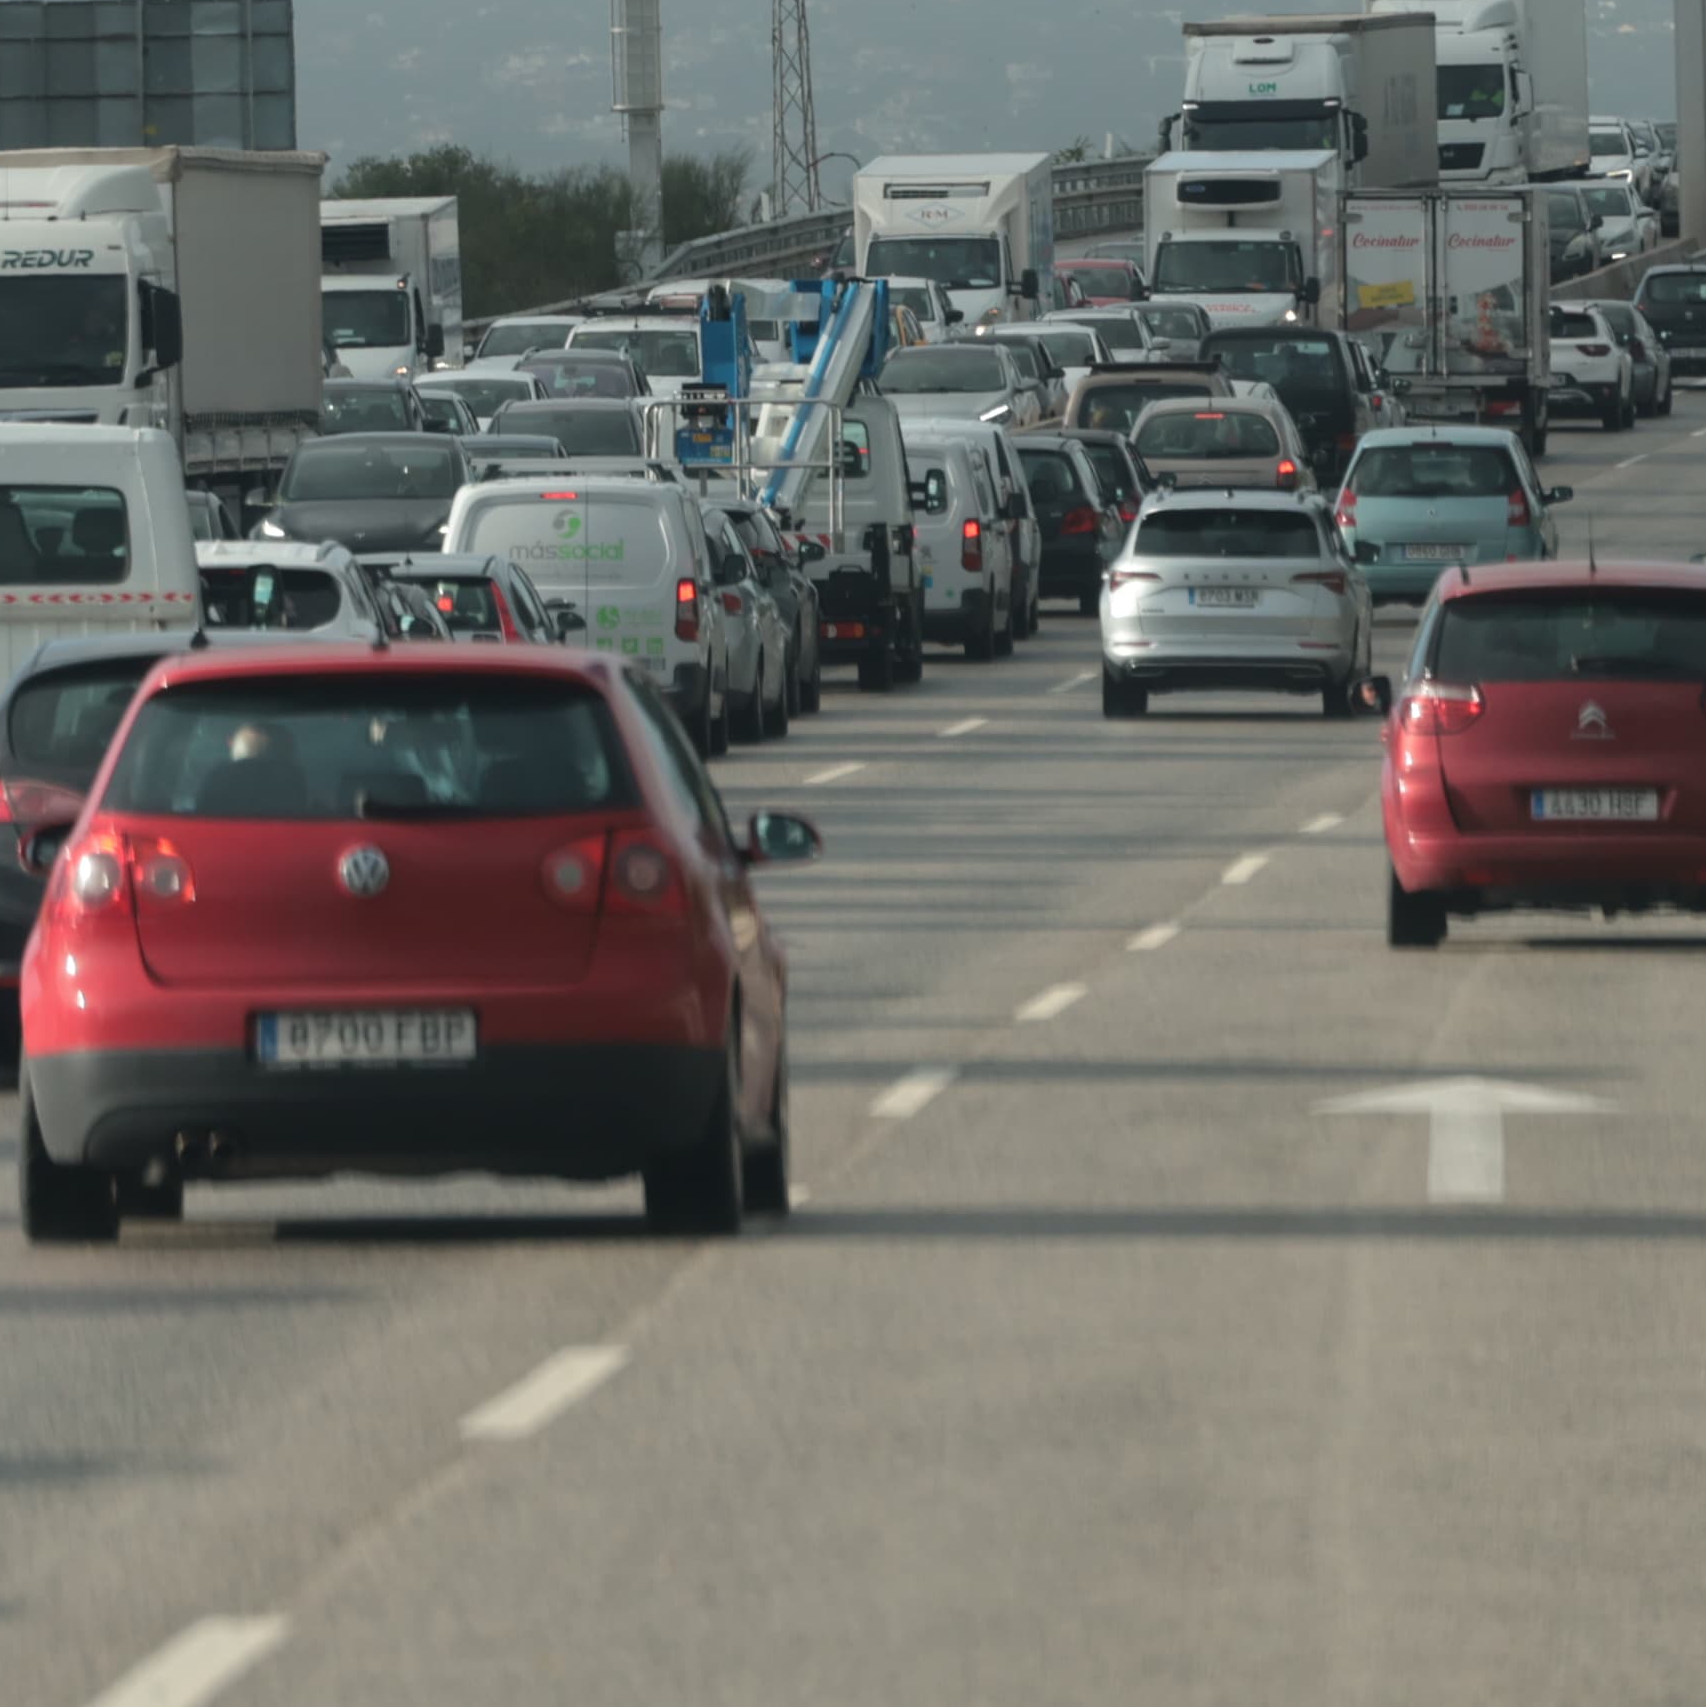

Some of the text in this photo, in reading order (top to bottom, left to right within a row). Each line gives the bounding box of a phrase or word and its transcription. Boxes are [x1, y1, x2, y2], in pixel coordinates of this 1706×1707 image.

[1248, 82, 1277, 94] LOM
[1352, 232, 1421, 250] Cocinatur
[1447, 232, 1516, 250] Cocinatur
[1, 249, 95, 269] REDUR
